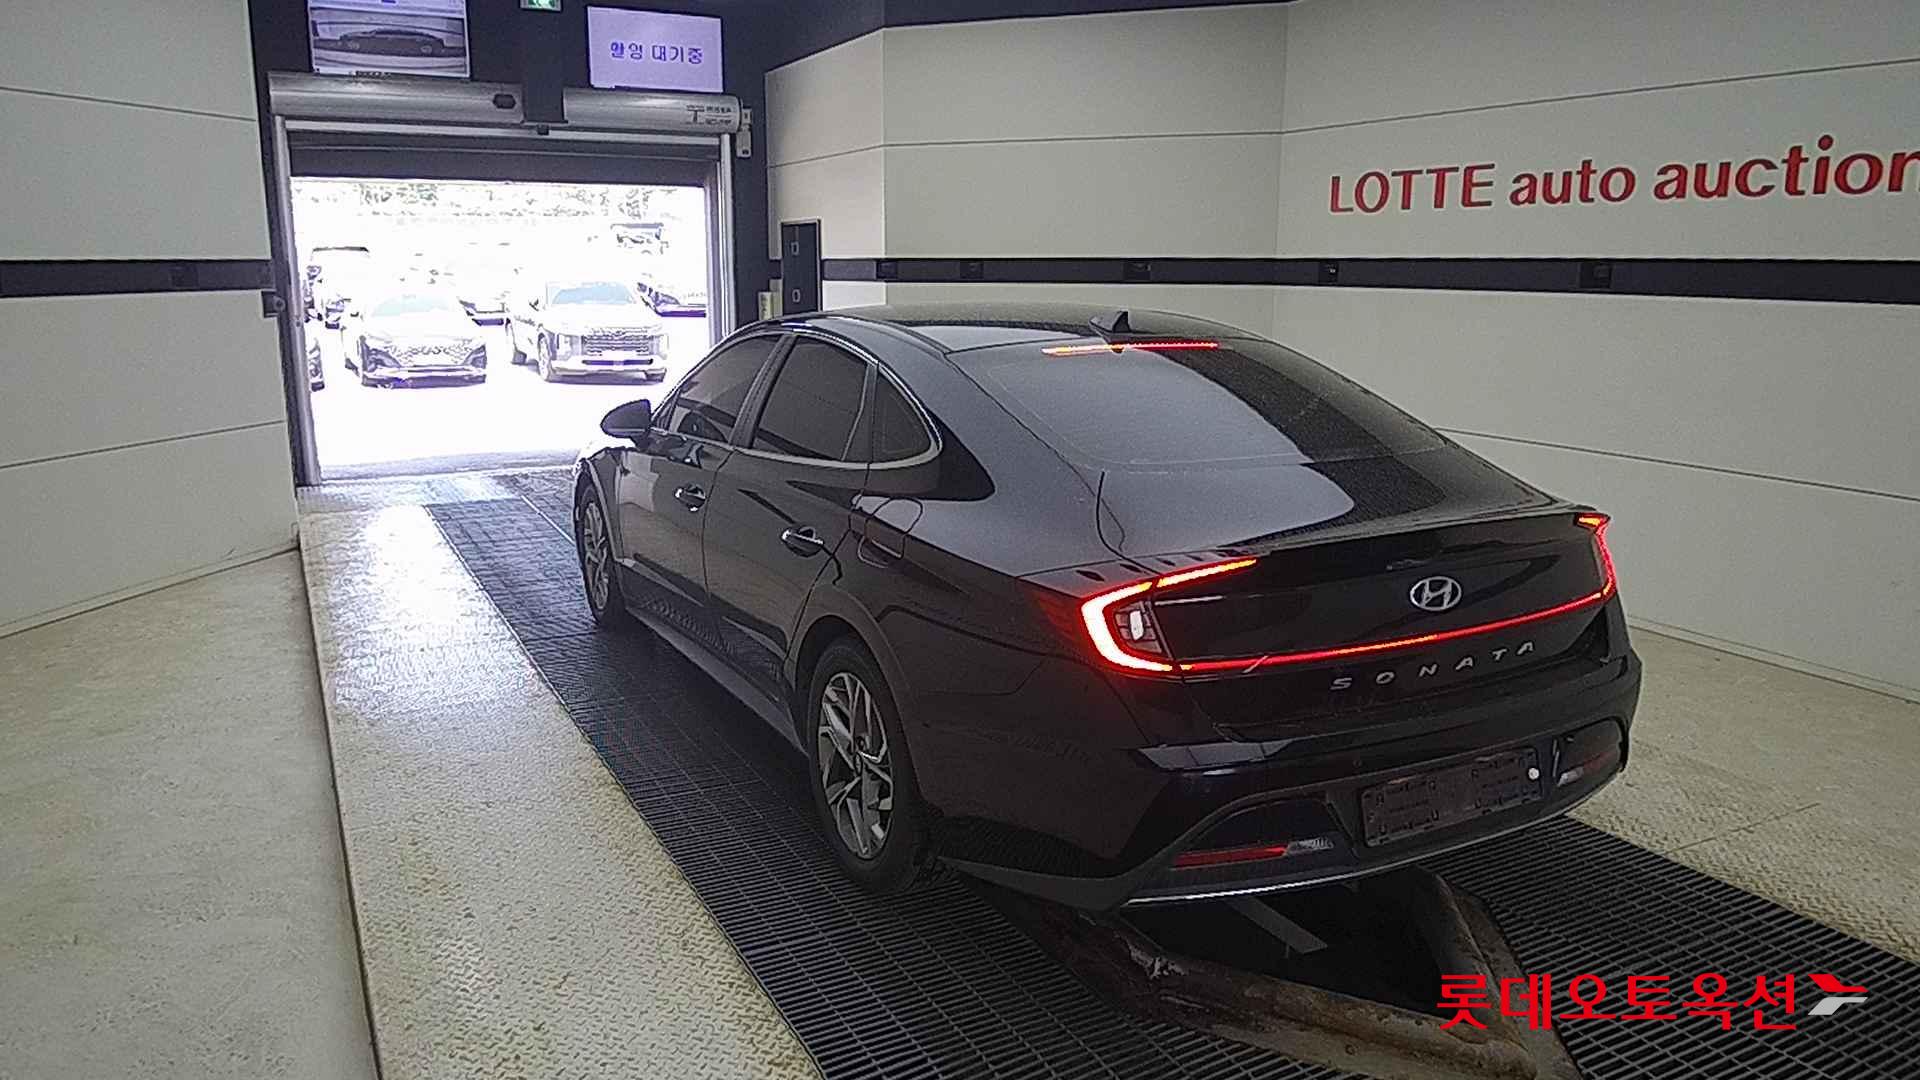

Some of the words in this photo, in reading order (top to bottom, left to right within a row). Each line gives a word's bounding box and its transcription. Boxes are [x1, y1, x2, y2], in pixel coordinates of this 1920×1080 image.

[651, 44, 703, 65] 대기중
[1330, 162, 1496, 214] LOTTE
[1509, 158, 1636, 206] auto
[1330, 641, 1536, 690] SONATA
